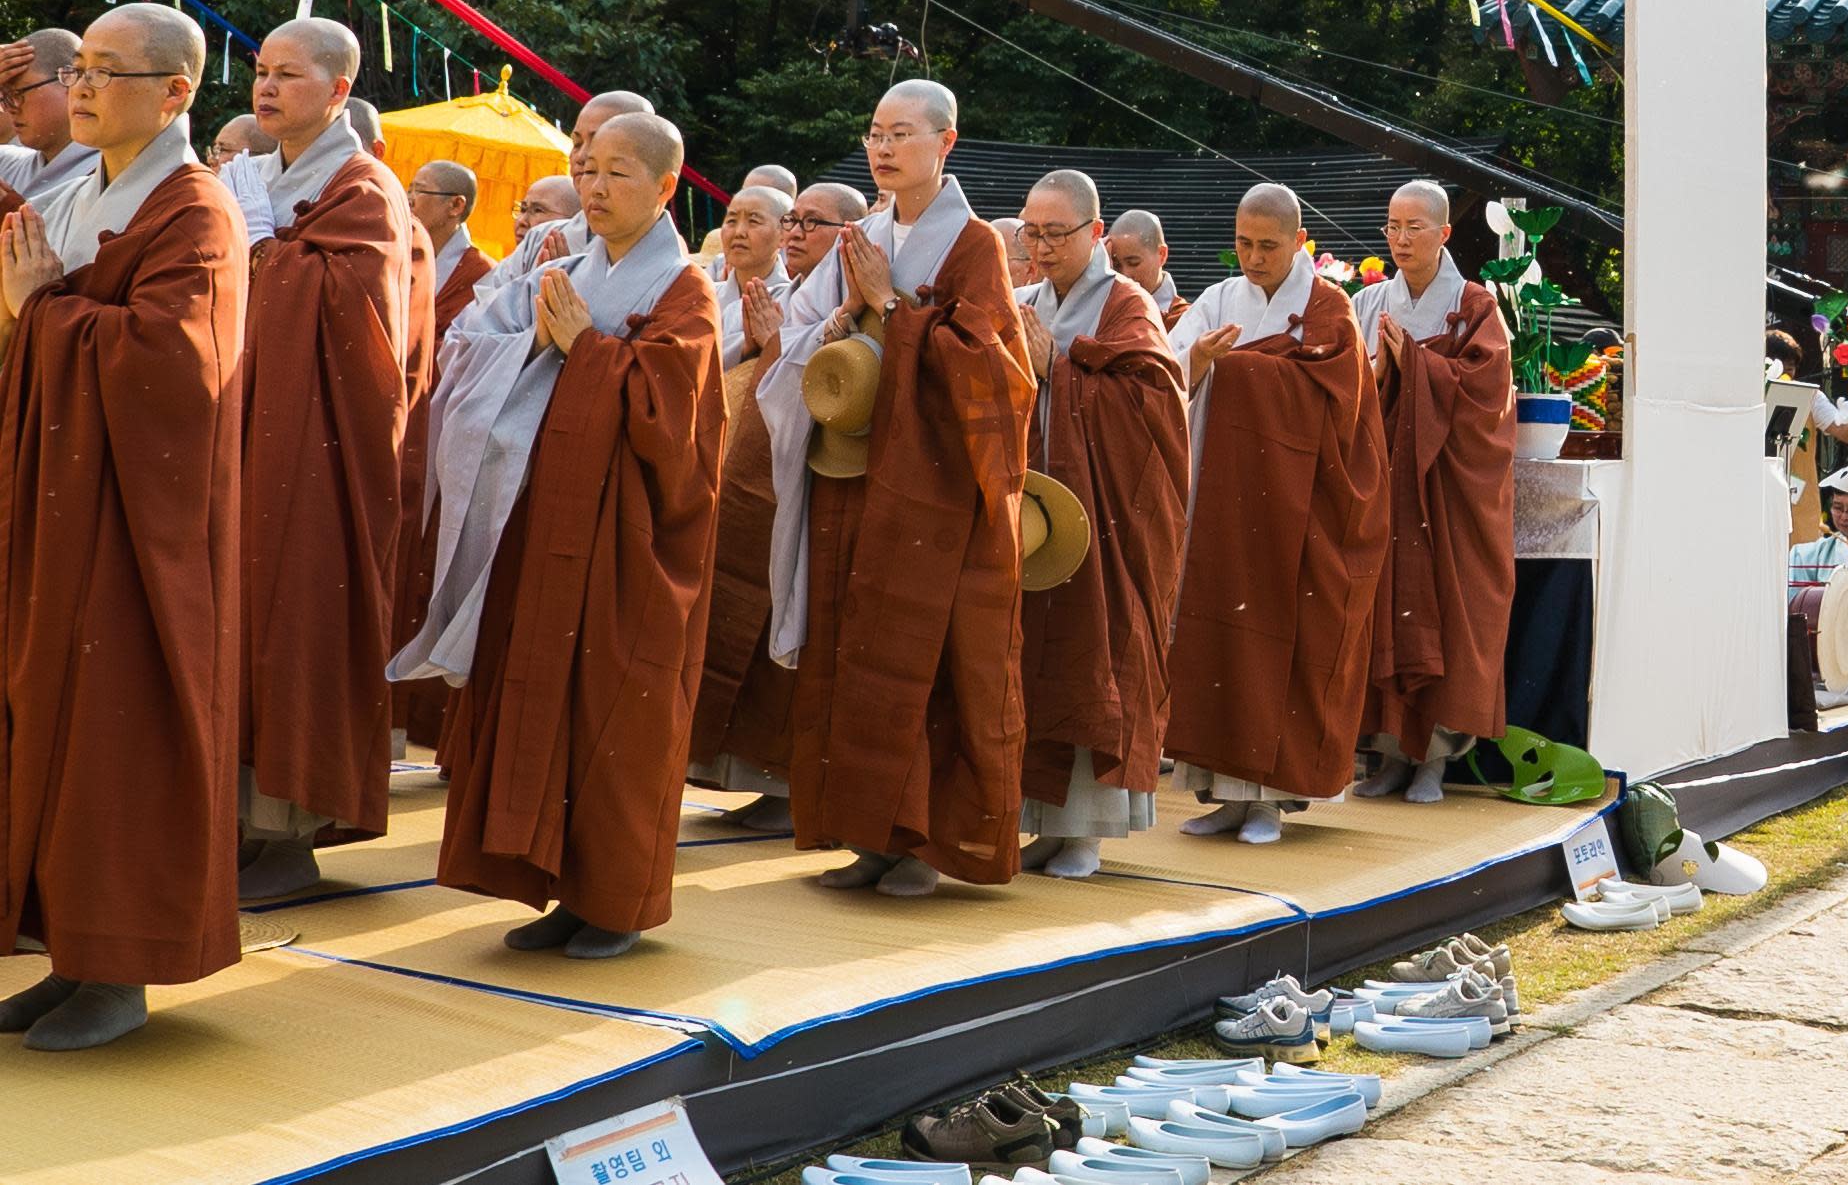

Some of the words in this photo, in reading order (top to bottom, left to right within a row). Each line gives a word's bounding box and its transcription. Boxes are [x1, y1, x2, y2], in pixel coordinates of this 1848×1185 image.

[1573, 838, 1606, 865] 포토라인
[591, 1148, 647, 1185] 촬영팀
[651, 1139, 673, 1163] 외
